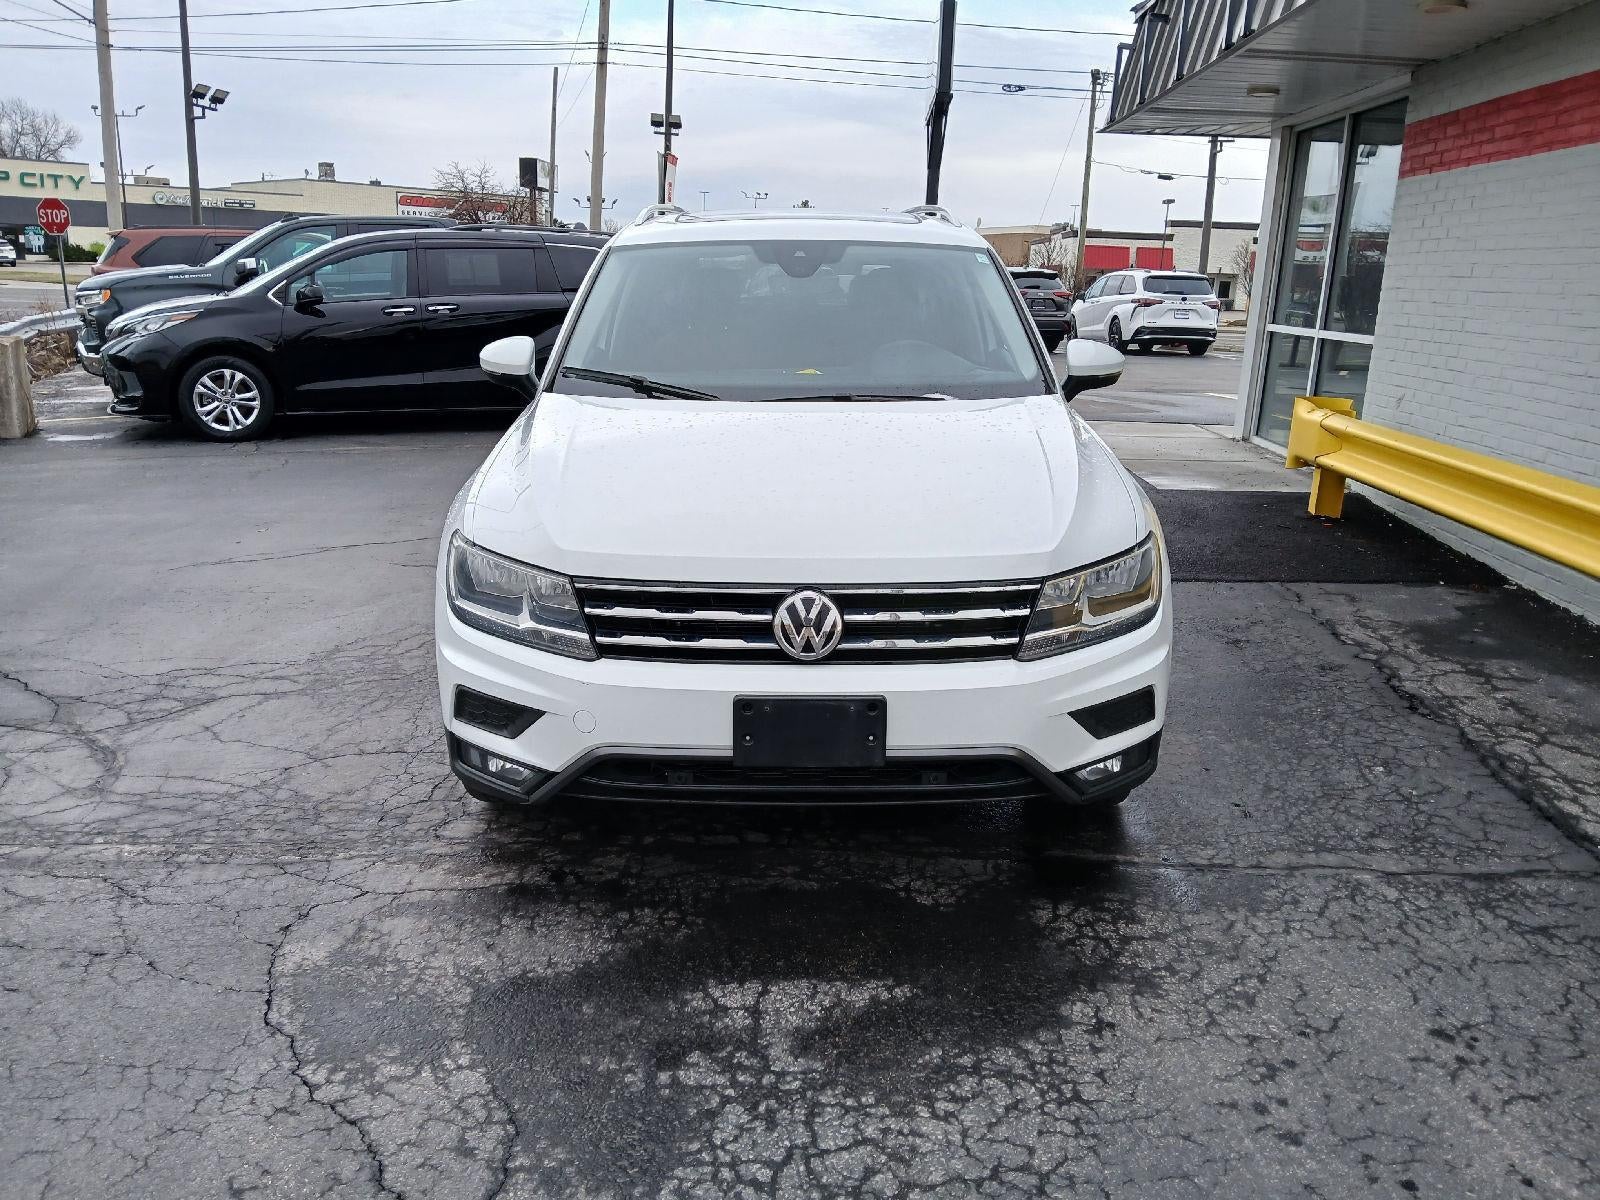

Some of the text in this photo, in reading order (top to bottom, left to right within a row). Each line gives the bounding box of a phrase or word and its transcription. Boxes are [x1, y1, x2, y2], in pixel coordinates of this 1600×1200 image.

[20, 172, 85, 190] CITY
[39, 209, 68, 224] STOP
[775, 591, 840, 659] VW
